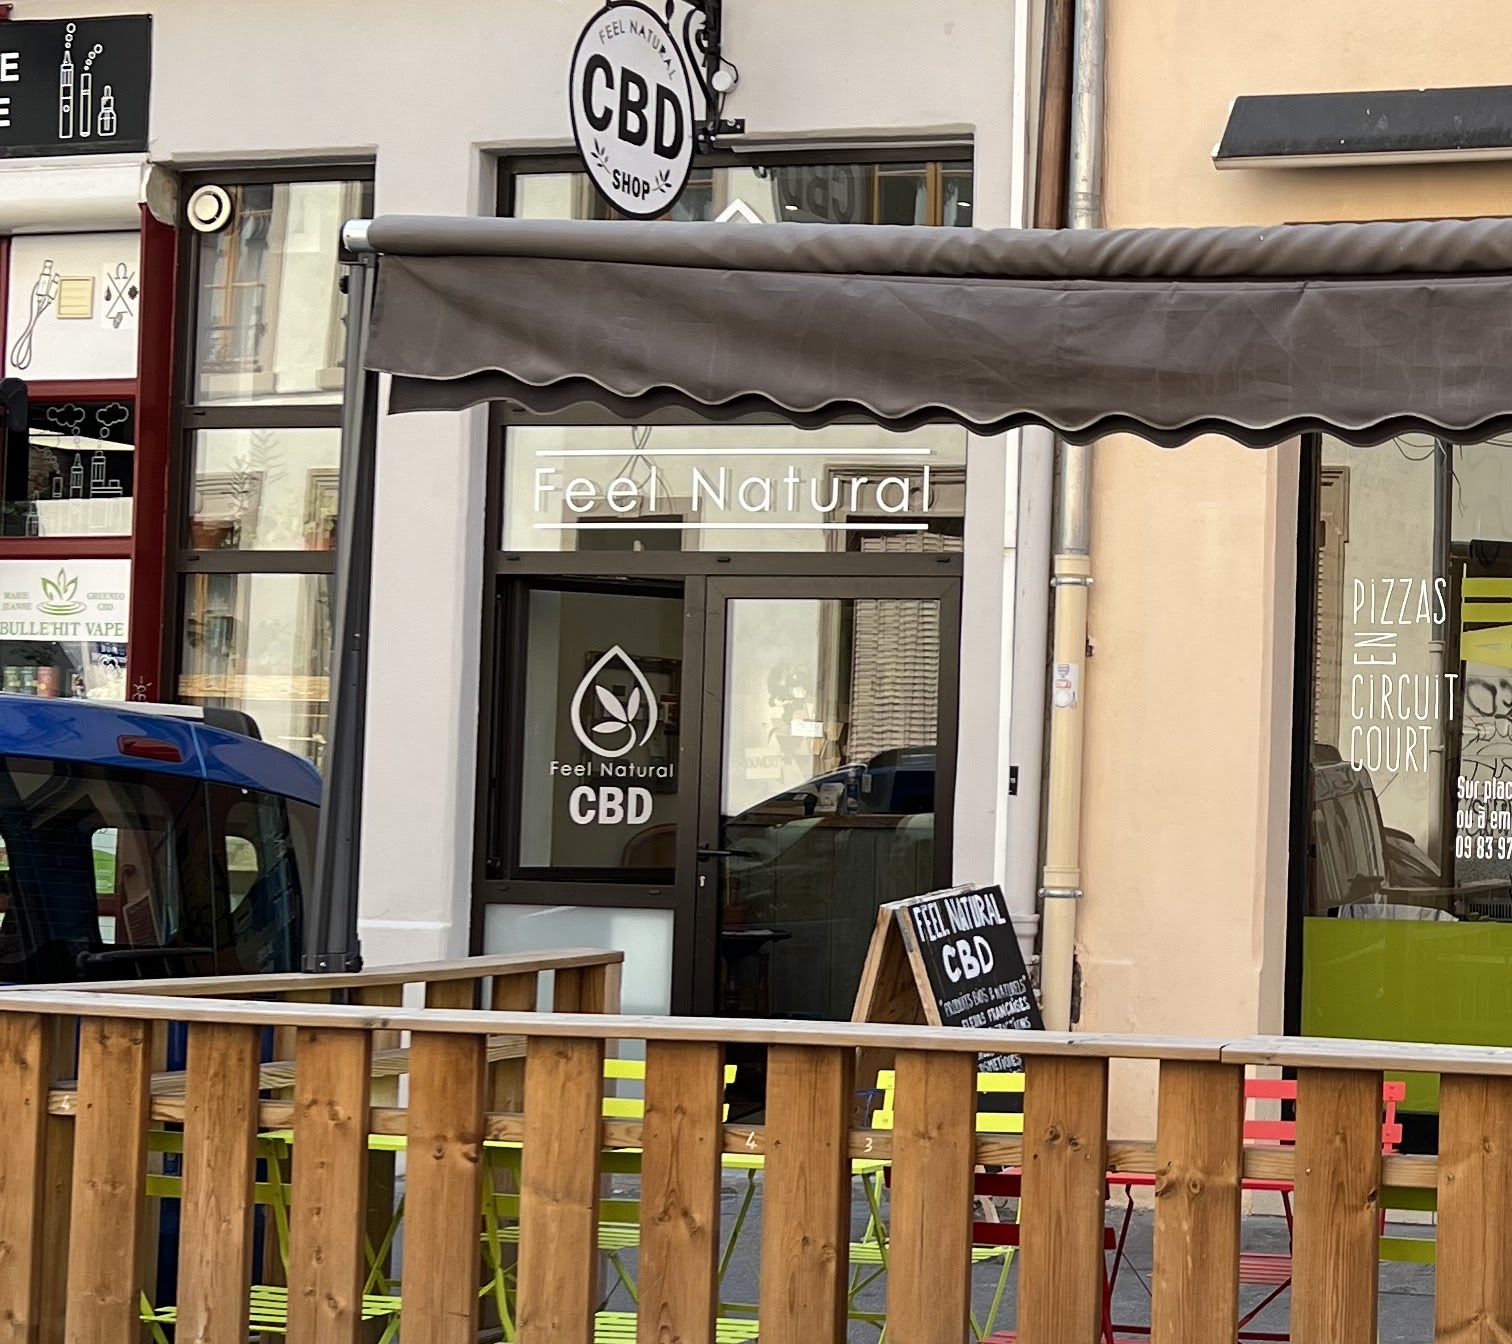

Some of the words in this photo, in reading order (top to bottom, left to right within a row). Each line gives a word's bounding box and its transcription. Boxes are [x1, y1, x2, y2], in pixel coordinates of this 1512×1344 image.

[599, 19, 626, 45] FEEL
[629, 20, 679, 81] NATURAL
[582, 53, 684, 160] CBD
[612, 168, 651, 201] SHOP
[533, 465, 656, 513] Feel
[691, 465, 931, 513] Natural
[81, 622, 124, 637] VAPE
[1353, 632, 1397, 665] EN
[1351, 725, 1431, 772] COURT
[549, 760, 592, 777] Feel
[600, 761, 675, 778] Natural
[568, 785, 653, 825] CBD
[1457, 777, 1481, 800] Sur
[1456, 809, 1473, 828] ou
[1478, 805, 1486, 829] à
[1455, 835, 1473, 859] 09
[1477, 836, 1493, 859] 83
[912, 901, 951, 943] FEEL
[944, 892, 1007, 934] NATURAL
[942, 935, 994, 983] CBD
[745, 1131, 757, 1149] 4
[863, 1137, 873, 1153] 3
